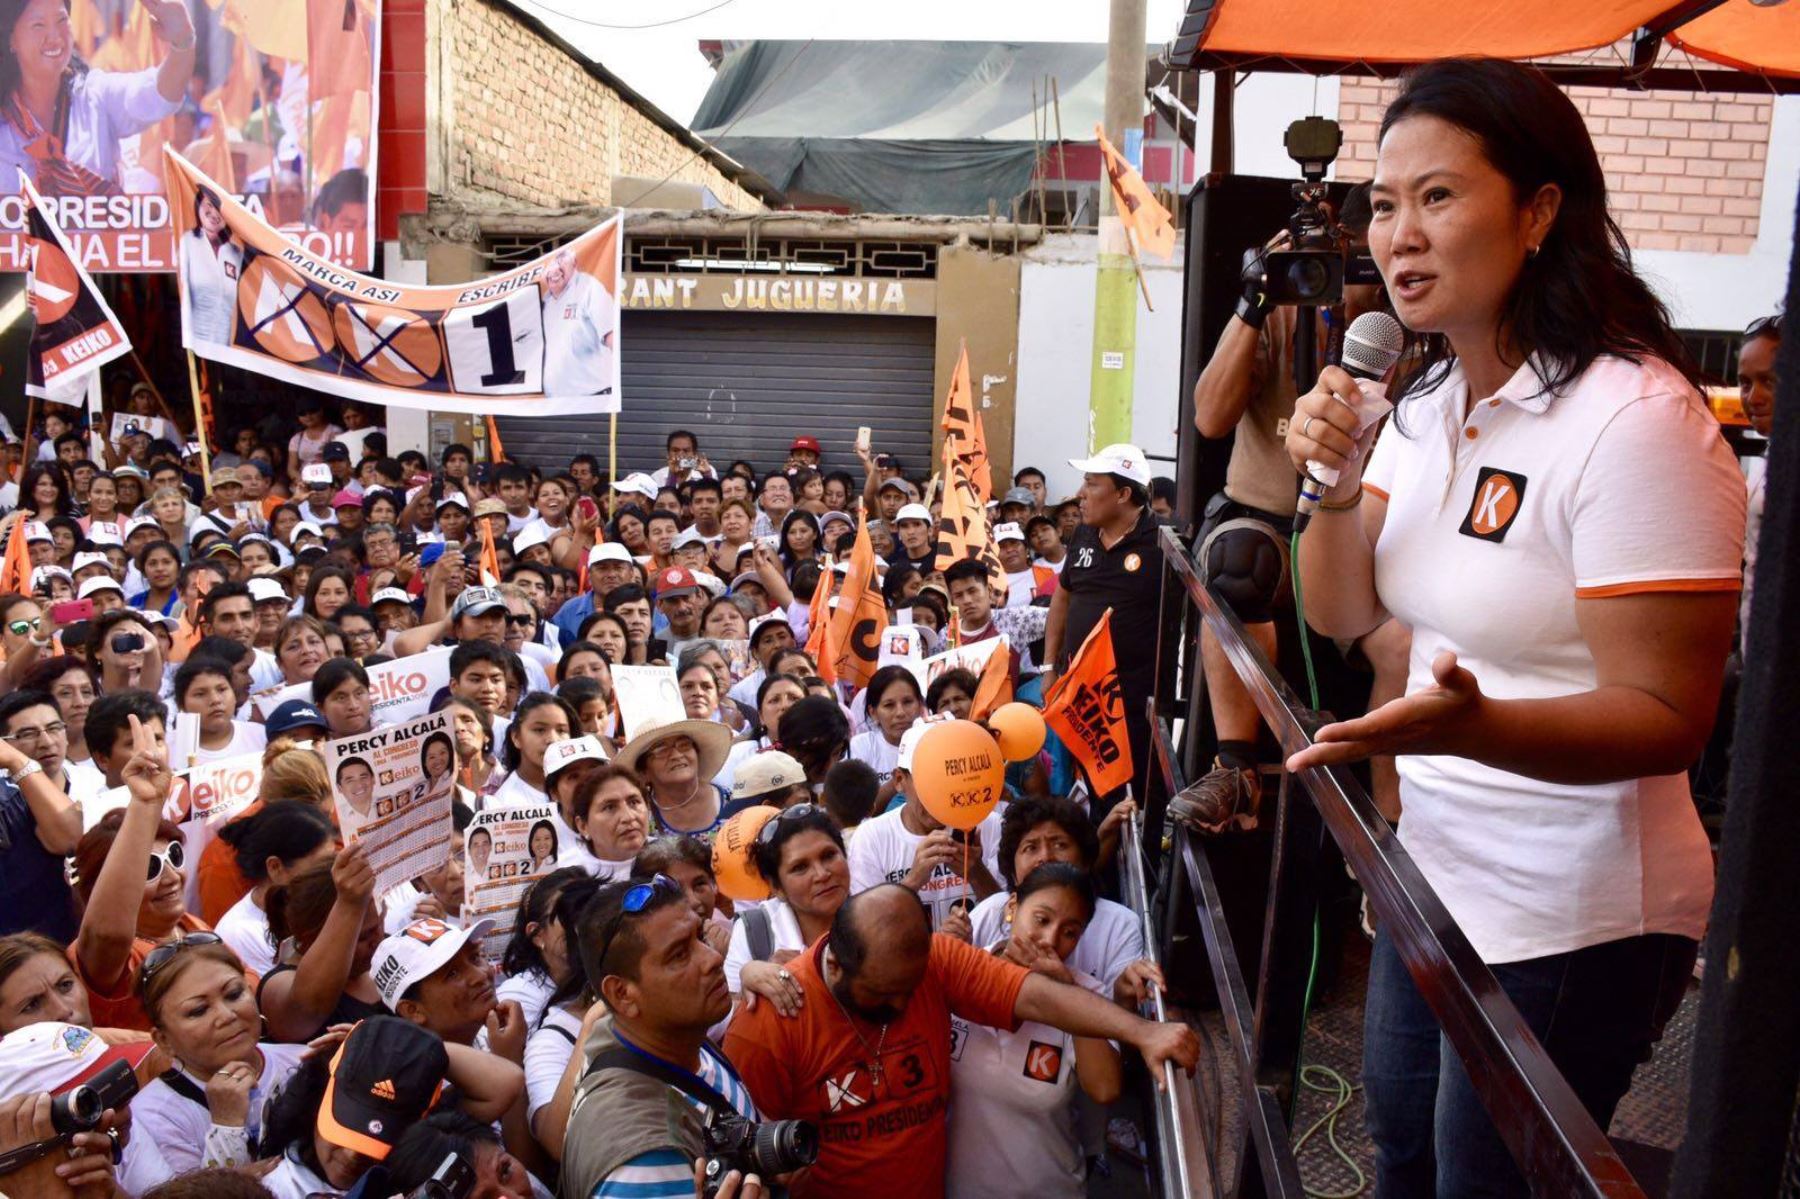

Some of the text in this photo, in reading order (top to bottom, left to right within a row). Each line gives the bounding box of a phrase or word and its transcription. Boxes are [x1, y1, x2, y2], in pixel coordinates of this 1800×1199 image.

[117, 233, 165, 268] EL
[361, 286, 400, 302] ASI
[721, 277, 907, 312] JUGUERIA
[60, 328, 113, 365] KEIKO
[473, 301, 526, 387] 1
[1475, 481, 1512, 529] K
[1073, 547, 1095, 568] 26
[369, 671, 428, 705] eiko
[336, 712, 447, 757] PERCY ALCALÁ
[414, 784, 426, 800] 2
[982, 786, 992, 803] 2
[511, 807, 553, 822] ALCALÁ
[520, 861, 530, 875] 2
[1030, 1046, 1056, 1078] K
[826, 1055, 924, 1112] K 3
